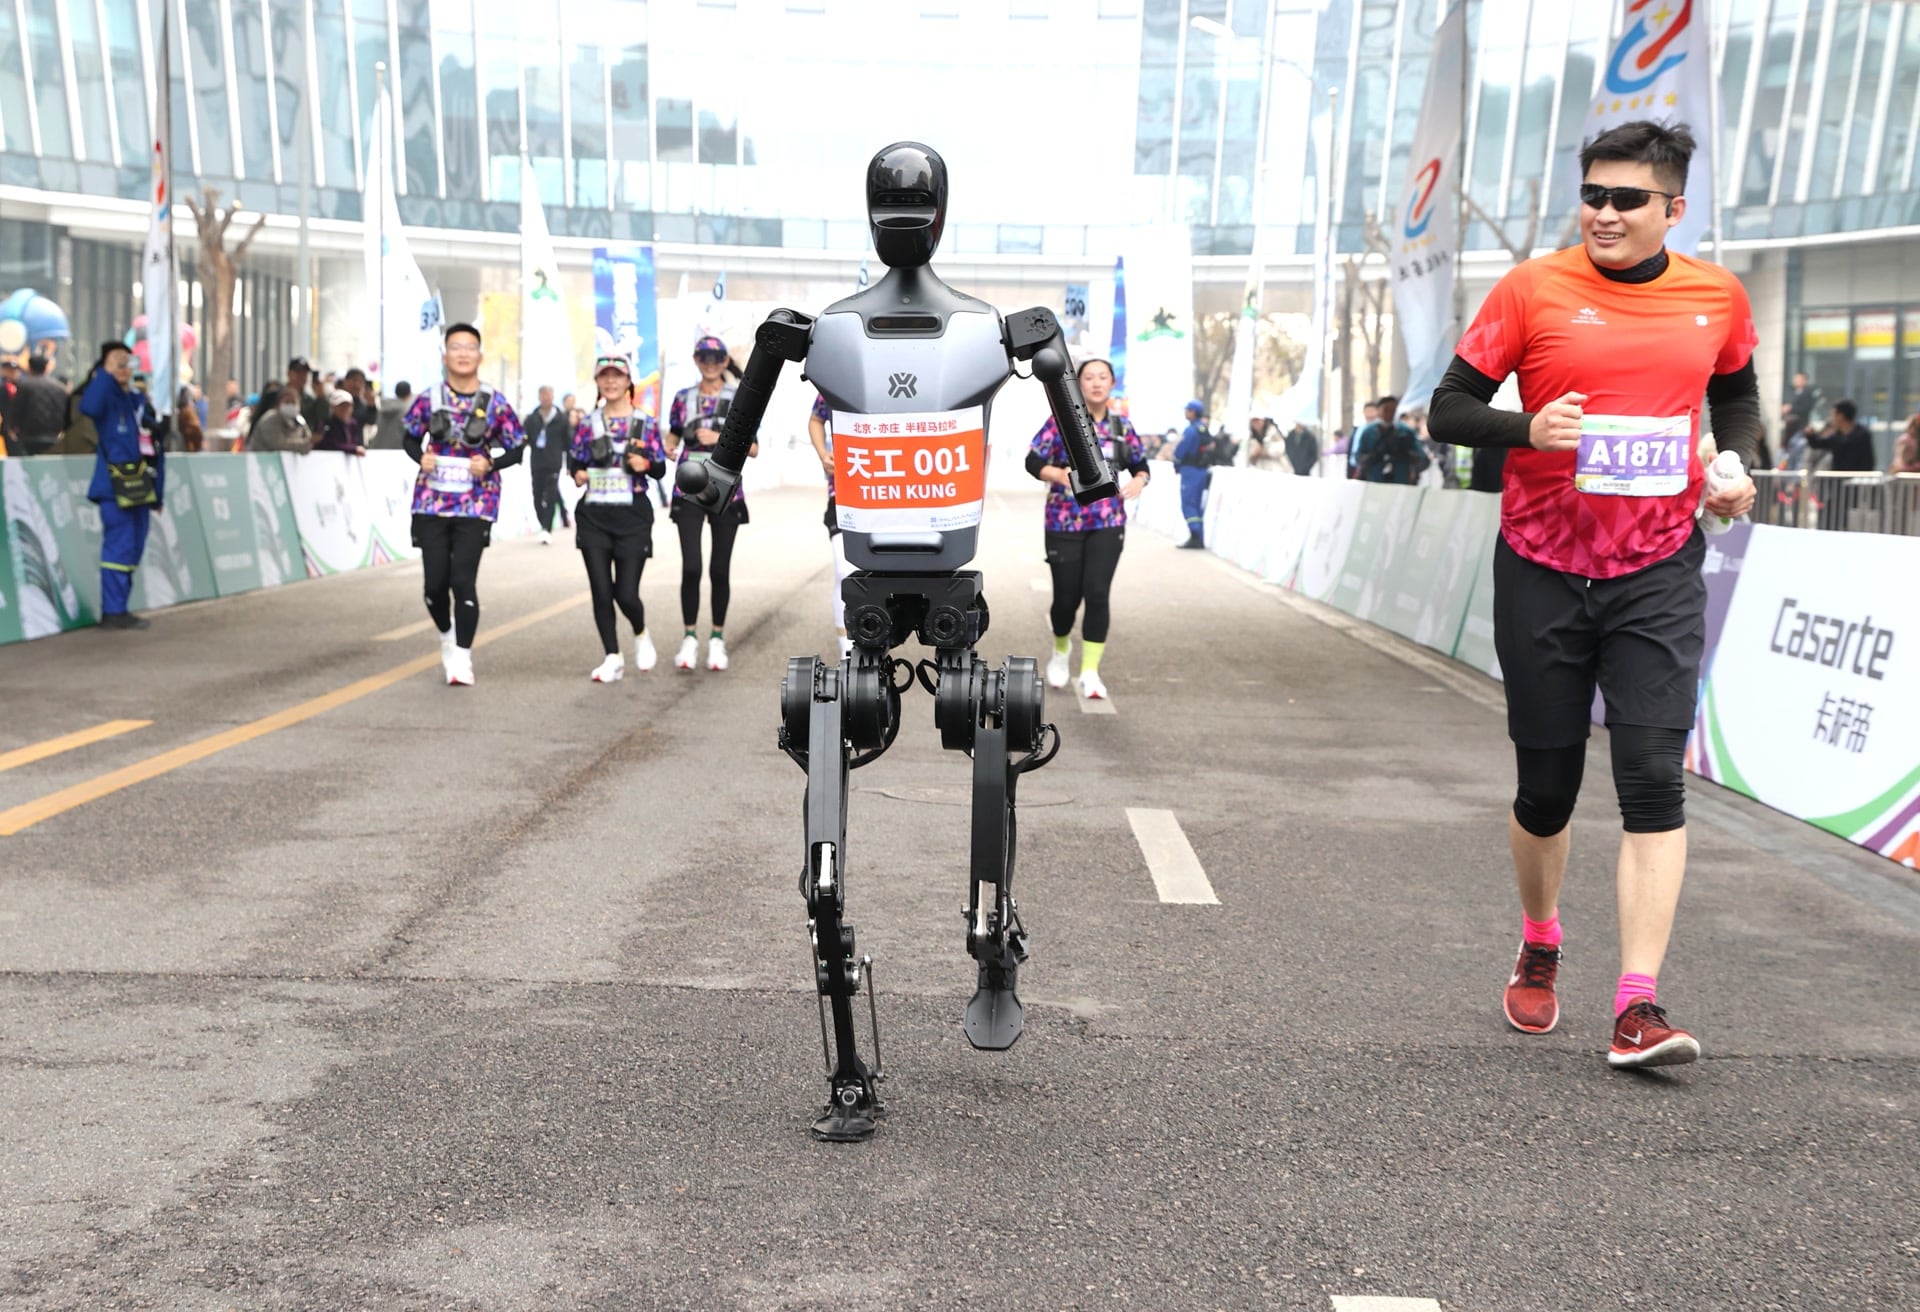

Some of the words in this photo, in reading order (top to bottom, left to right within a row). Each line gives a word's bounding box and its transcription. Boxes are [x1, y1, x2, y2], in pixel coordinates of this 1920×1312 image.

[906, 419, 957, 433] 半程马拉松
[847, 446, 905, 479] 天工
[914, 445, 970, 476] 001
[860, 485, 900, 500] TIEN
[906, 482, 957, 499] KUNG
[1770, 597, 1894, 681] Casarte
